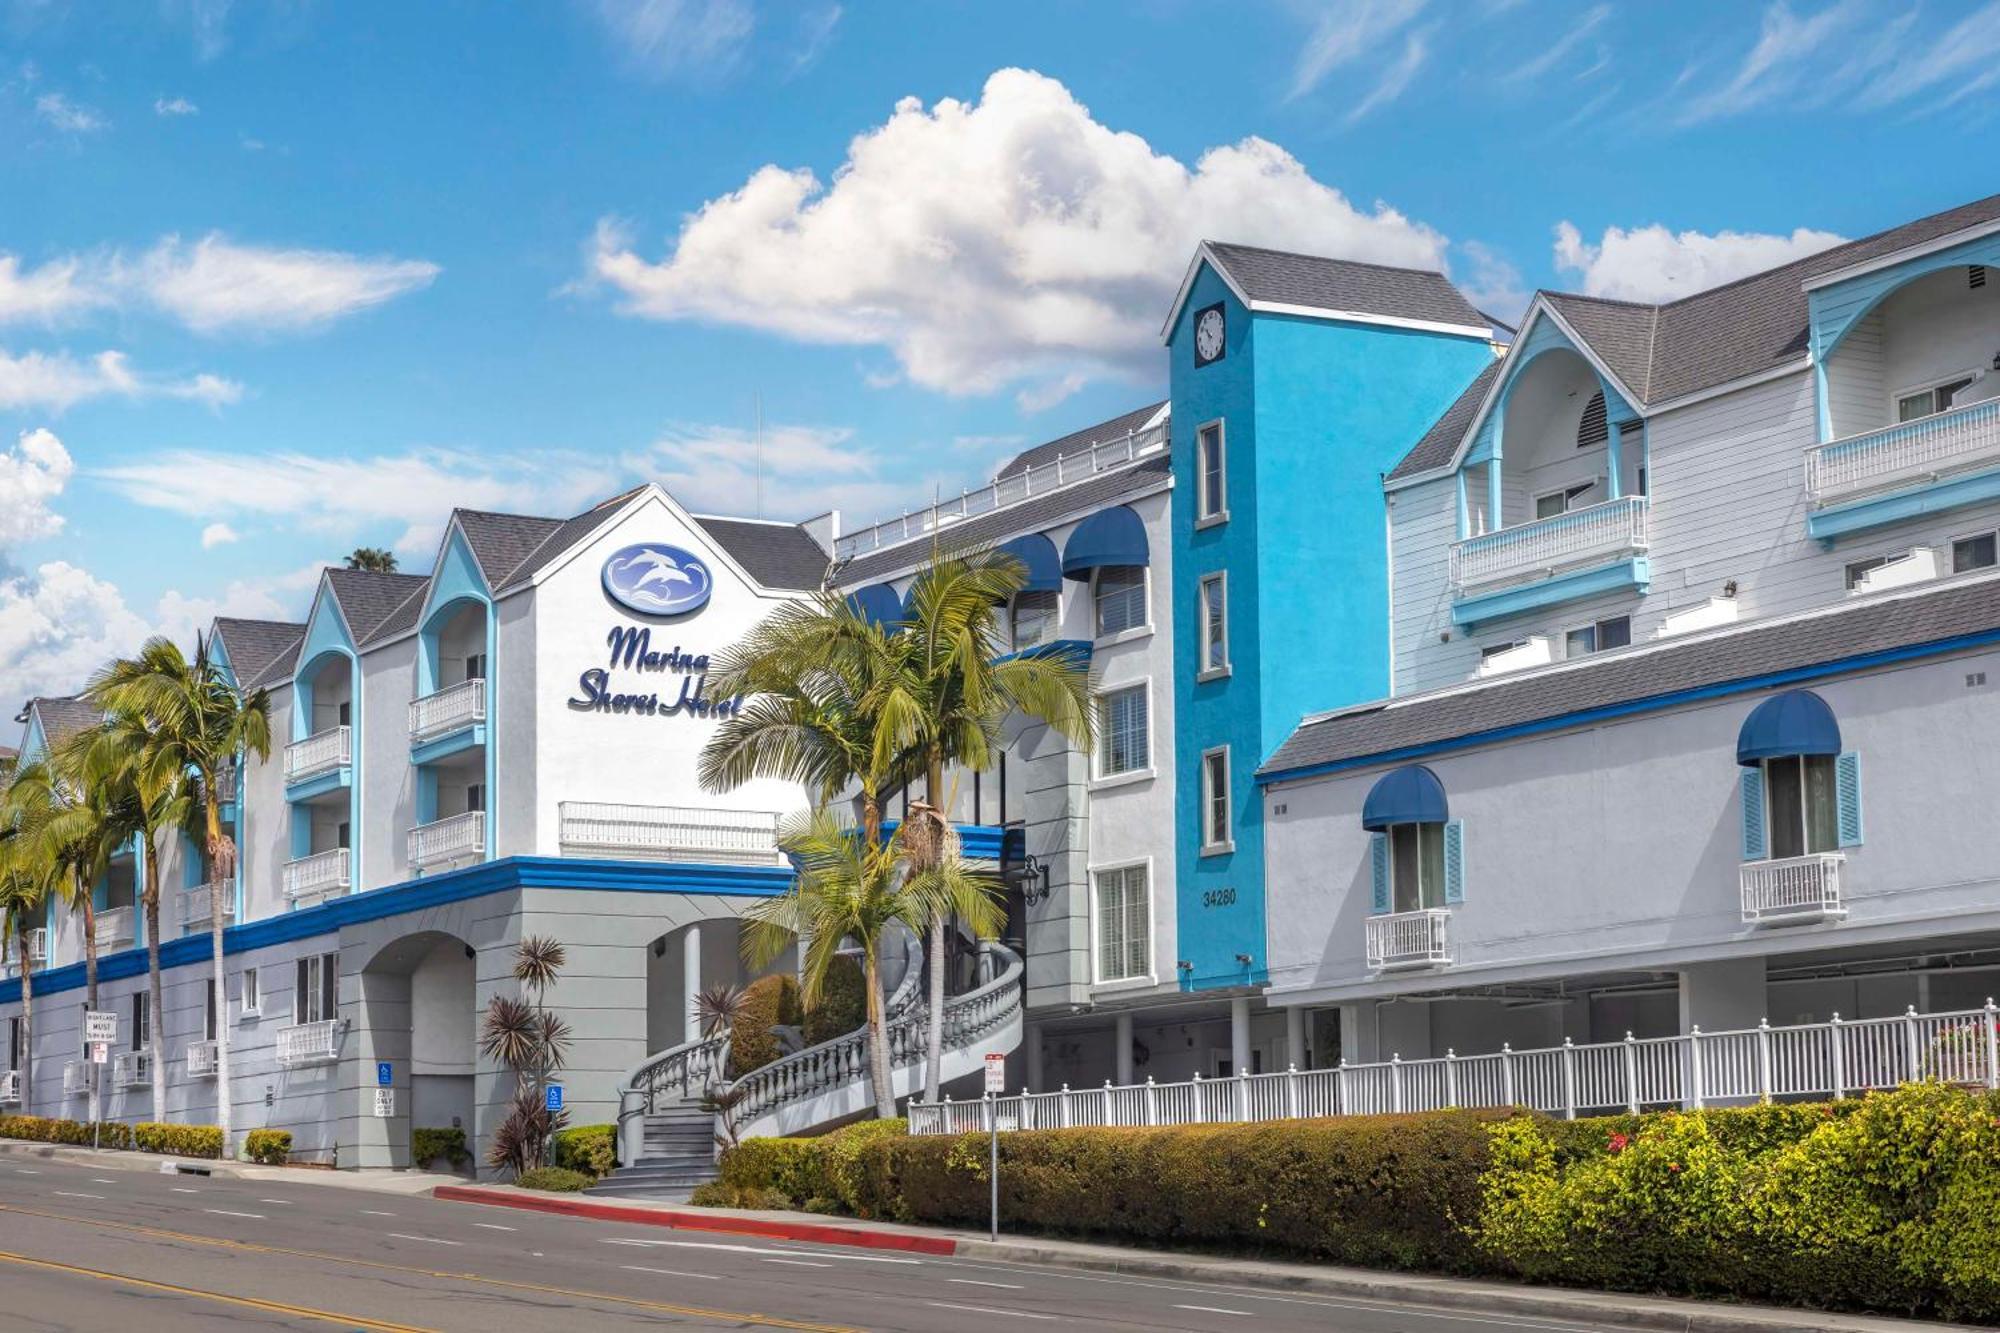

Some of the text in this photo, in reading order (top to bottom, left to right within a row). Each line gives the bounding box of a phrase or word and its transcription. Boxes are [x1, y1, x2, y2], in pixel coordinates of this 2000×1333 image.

[607, 626, 710, 672] Marina
[568, 668, 657, 715] Shores
[1203, 888, 1236, 907] 34280
[93, 1023, 111, 1031] MUST
